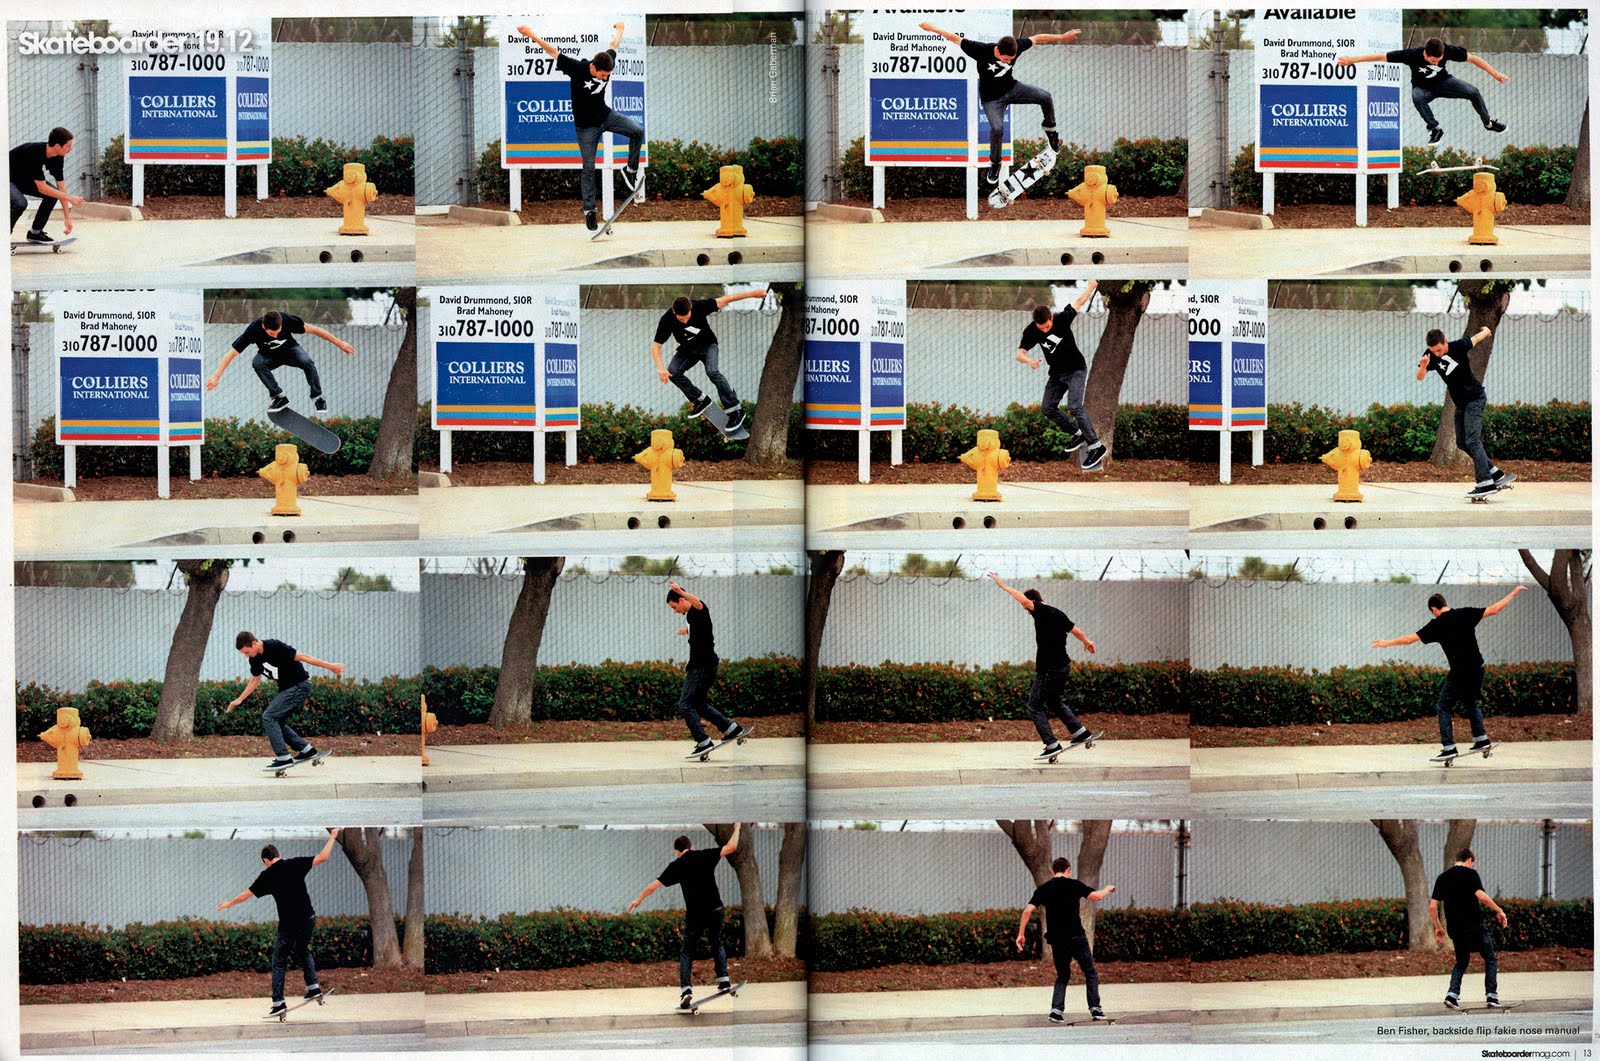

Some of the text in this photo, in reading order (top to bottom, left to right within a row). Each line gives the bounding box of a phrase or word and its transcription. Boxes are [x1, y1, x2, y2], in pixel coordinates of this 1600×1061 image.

[508, 35, 530, 43] David
[581, 34, 599, 43] SIOR
[873, 33, 895, 41] David
[897, 33, 944, 41] Drummond,
[890, 43, 946, 54] Brad Mahoney
[1264, 39, 1355, 48] David Drummond, SIOR
[1280, 50, 1336, 60] Brad Mahoney
[149, 54, 225, 71] 787-1000
[889, 56, 966, 73] 787-1000
[1280, 62, 1357, 80] 787-1000
[140, 95, 216, 108] COLLIERS
[238, 92, 268, 108] COLLIERS
[613, 96, 643, 111] COLLIERS
[882, 97, 957, 110] COLLIERS
[142, 110, 217, 118] INTERNATIONAL
[1271, 104, 1347, 117] COLLIERS
[1369, 102, 1398, 117] COLLIERS
[883, 112, 959, 121] INTERNATIONAL
[1273, 119, 1348, 127] INTERNATIONAL
[440, 296, 532, 305] David Drummond, SIOR
[840, 295, 858, 303] SIOR
[1200, 295, 1219, 303] SIOR
[64, 311, 156, 320] David Drummond, SIOR
[457, 307, 513, 318] Brad Mahoney
[811, 305, 840, 316] Mahoney
[80, 322, 137, 332] Brad Mahoney
[456, 320, 534, 337] 787-1000
[80, 335, 157, 352] 787-1000
[448, 361, 524, 374] COLLIERS
[546, 359, 576, 374] COLLIERS
[872, 358, 902, 373] COLLIERS
[1233, 358, 1264, 373] COLLIERS
[72, 376, 148, 389] COLLIERS
[170, 374, 200, 389] COLLIERS
[450, 376, 526, 384] INTERNATIONAL
[73, 391, 149, 399] INTERNATIONAL
